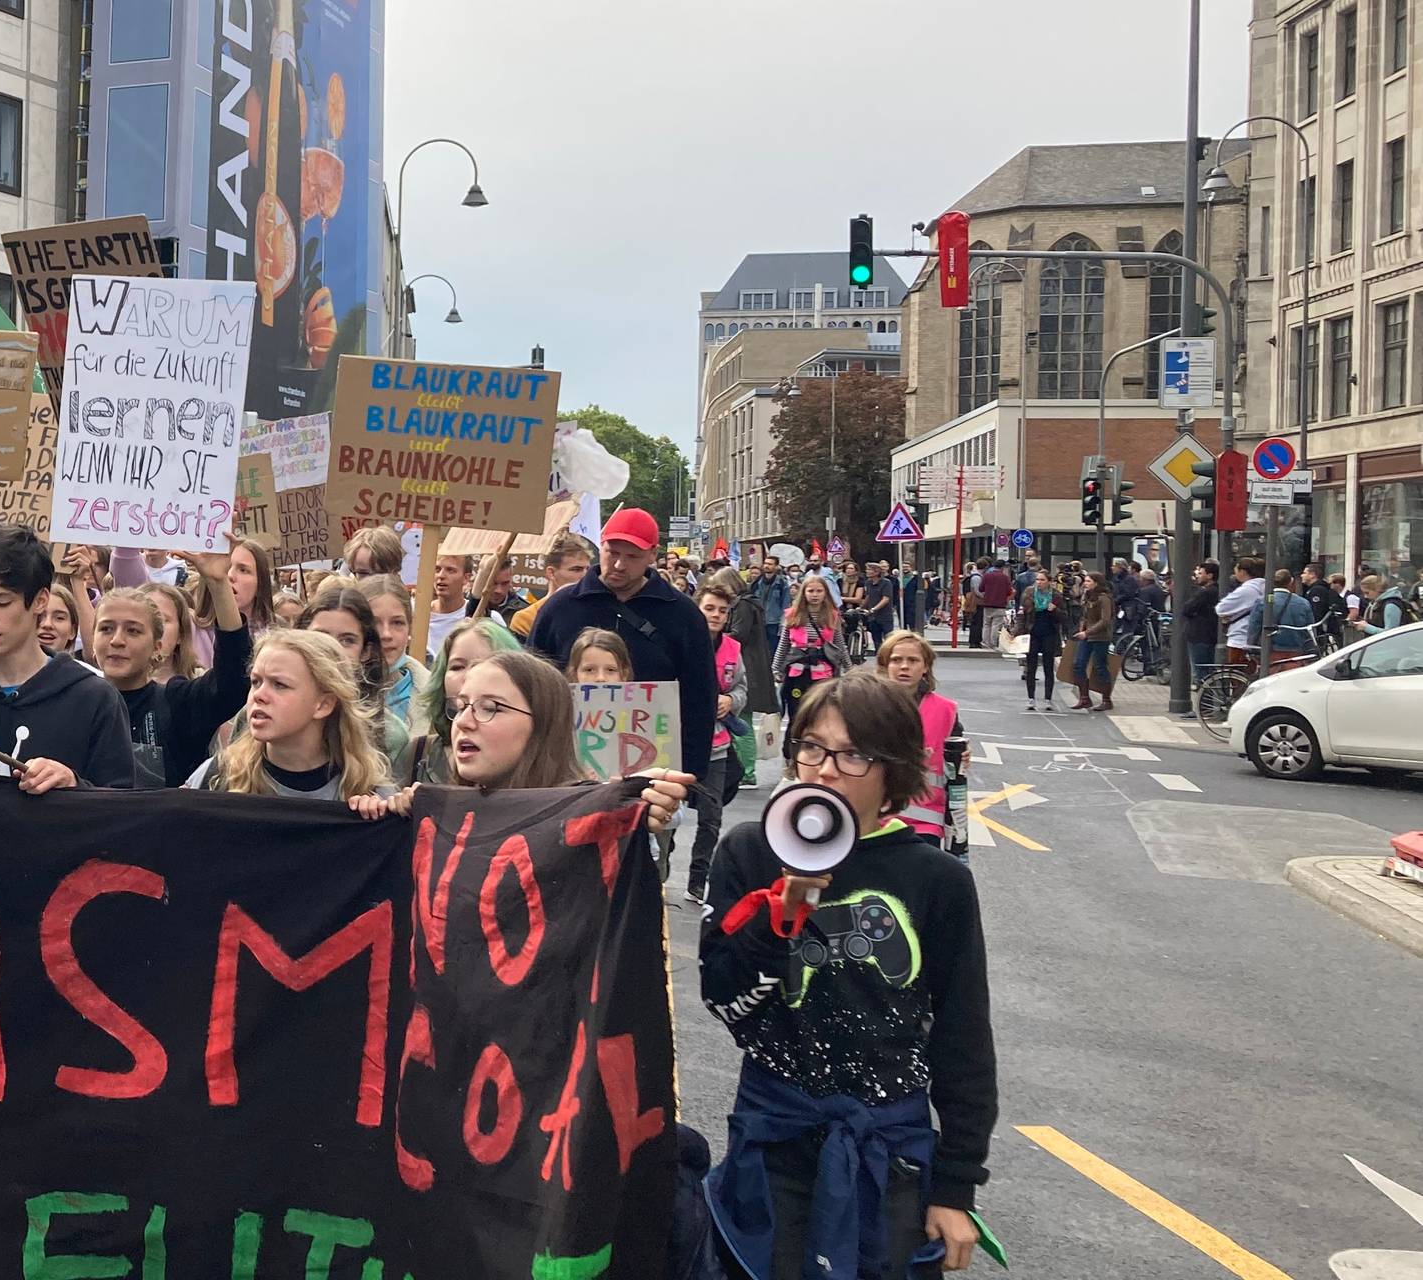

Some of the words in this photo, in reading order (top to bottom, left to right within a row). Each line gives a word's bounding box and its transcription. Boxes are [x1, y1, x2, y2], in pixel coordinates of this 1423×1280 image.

[3, 240, 66, 275] THE
[64, 231, 156, 270] EARTH
[16, 278, 48, 314] IS
[72, 278, 254, 348] WARUM
[67, 343, 108, 386] für
[114, 348, 147, 377] die
[153, 347, 237, 393] Zukunft
[371, 363, 550, 401] BLAUKRAUT
[69, 391, 236, 447] lernen
[365, 405, 544, 445] BLAUKRAUT
[338, 445, 524, 489] BRAUNKOHLE
[408, 437, 452, 453] und
[61, 440, 114, 484] WENN
[123, 445, 163, 490] IHR
[178, 449, 218, 495] SIE
[67, 497, 231, 549] zerstört?
[297, 528, 329, 546] THIS
[274, 546, 327, 566] HAPPEN
[525, 555, 546, 570] ist
[410, 801, 645, 1003] NOT
[394, 1003, 666, 1192] COAL
